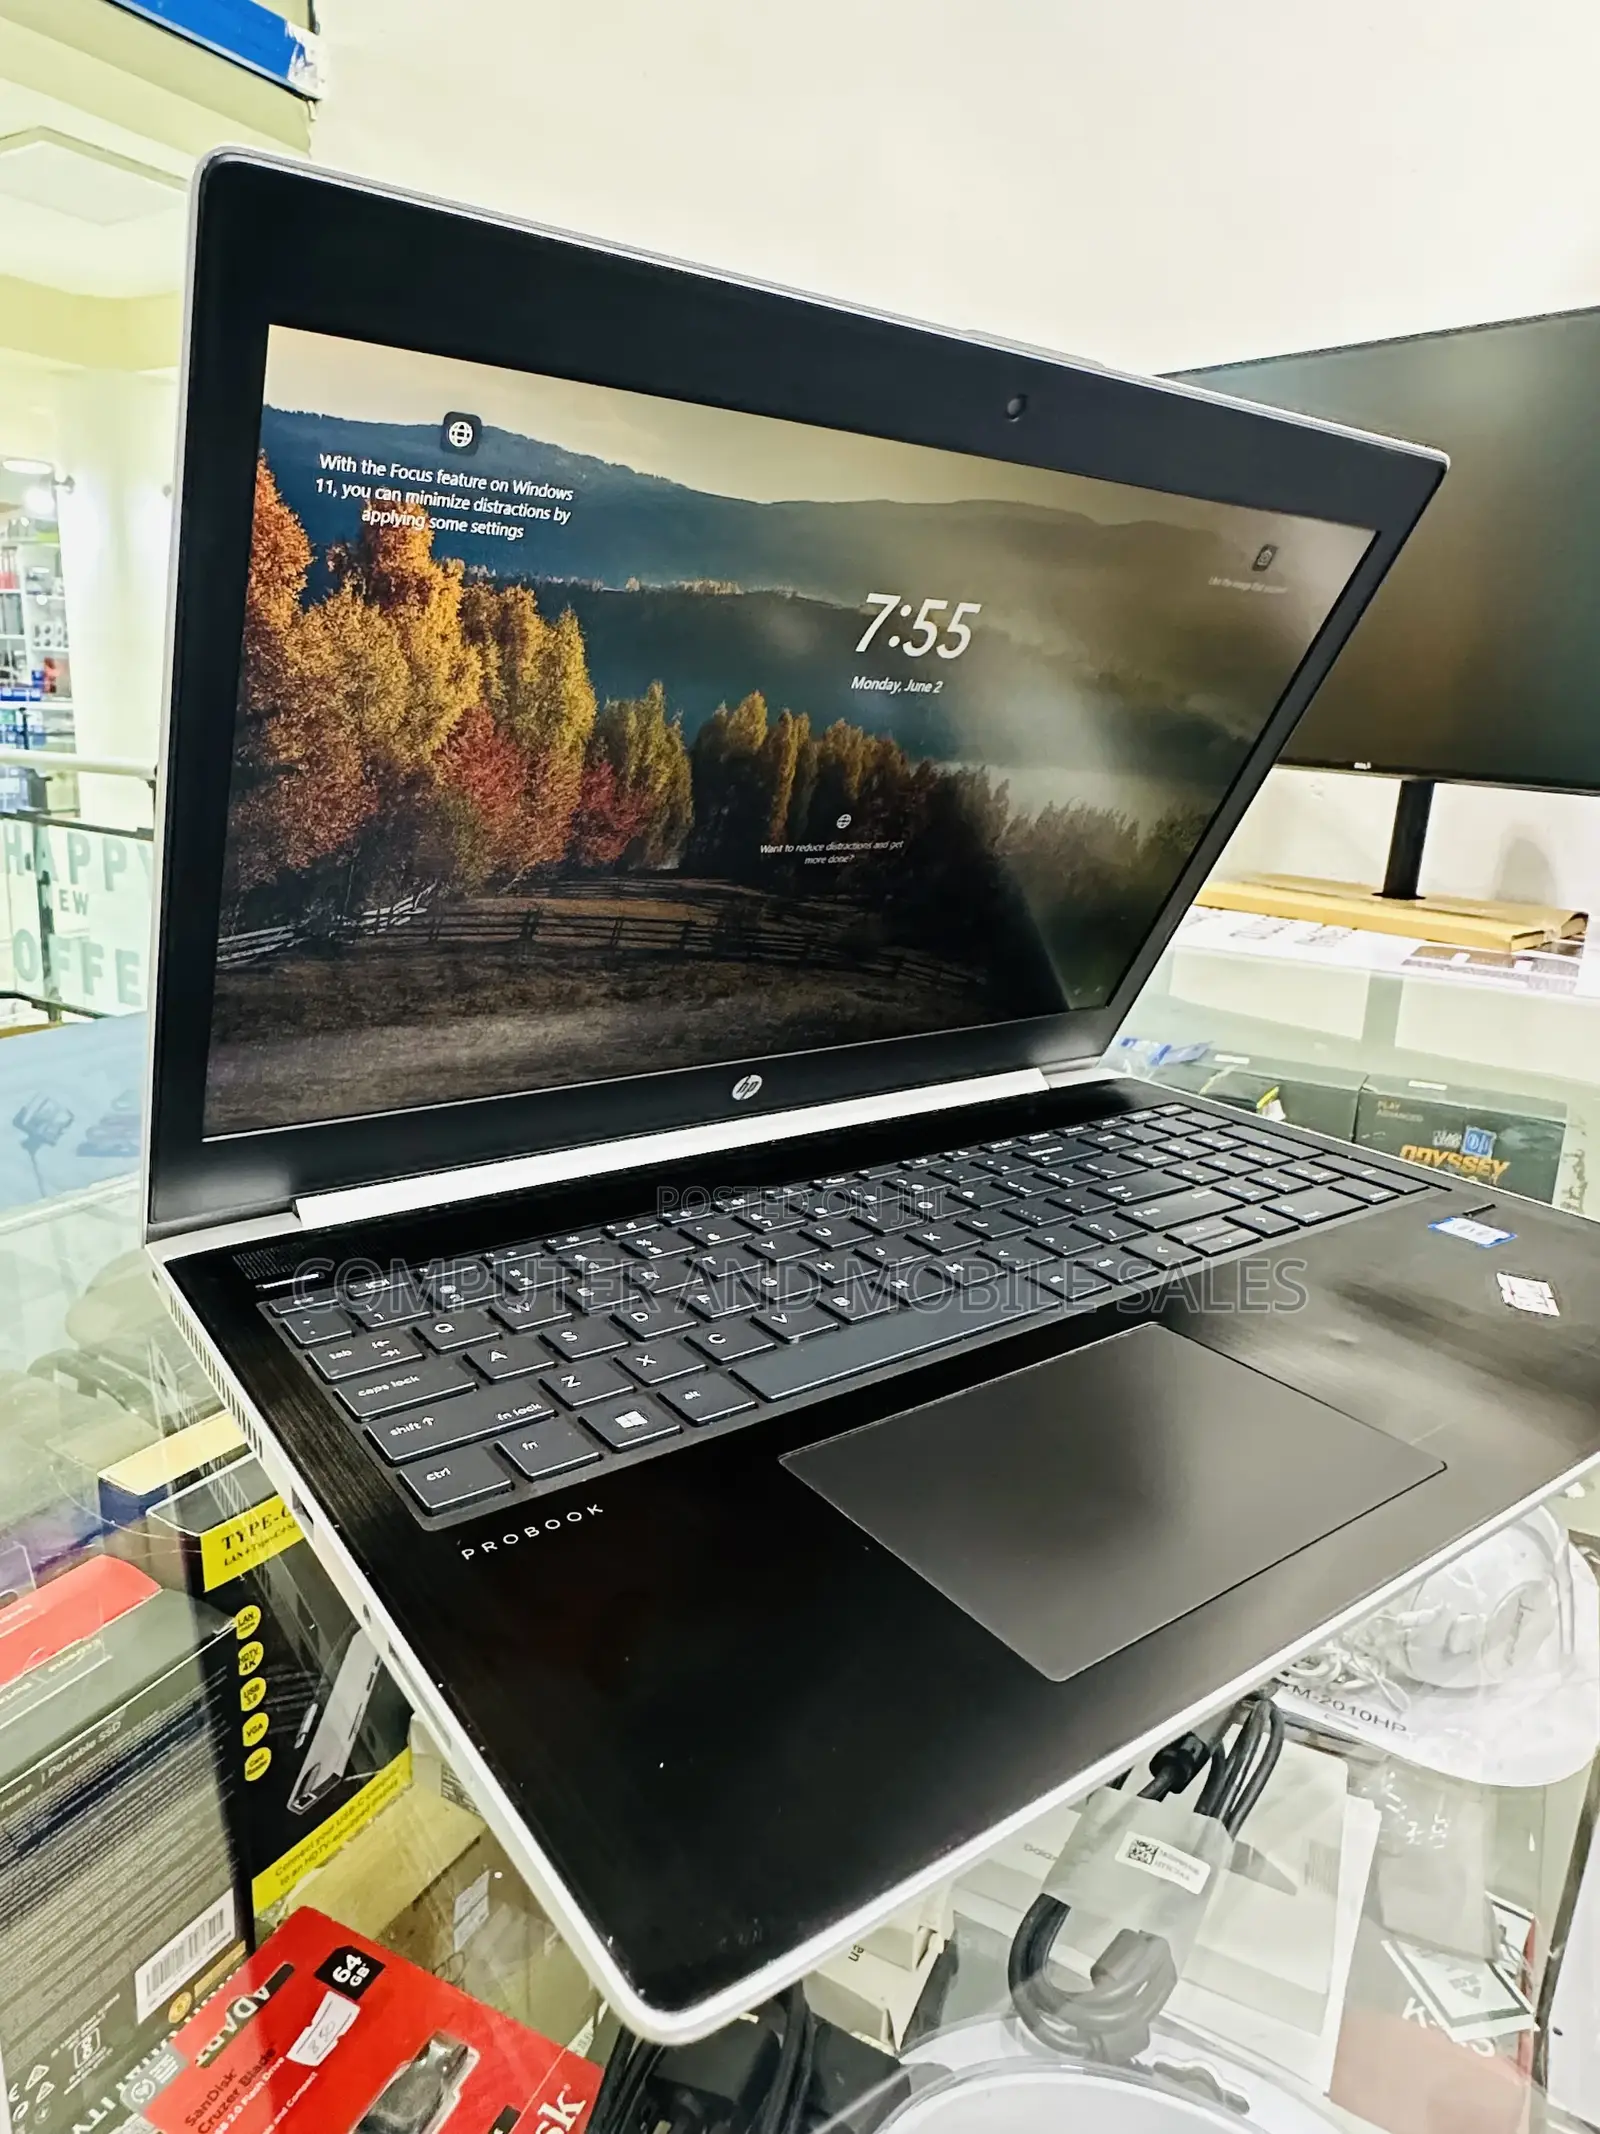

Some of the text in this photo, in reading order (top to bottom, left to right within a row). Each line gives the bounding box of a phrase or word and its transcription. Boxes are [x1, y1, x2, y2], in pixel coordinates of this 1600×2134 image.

[319, 454, 573, 501] With the Focus feature on Windows
[315, 478, 571, 525] 11, you can minimize distractions by
[361, 508, 524, 541] applying some settings
[855, 593, 982, 659] 7:55
[851, 676, 944, 694] Monday, June 2
[760, 840, 904, 854] Want to reduce distractions and get
[804, 854, 855, 865] more done?
[731, 1074, 763, 1101] hp
[761, 1240, 776, 1250] Y
[508, 1302, 531, 1314] W
[631, 1311, 649, 1323] D
[771, 1313, 788, 1324] V
[434, 1322, 455, 1334] Q
[561, 1331, 578, 1343] S
[708, 1333, 726, 1345] C
[328, 1349, 352, 1360] tab
[491, 1350, 508, 1362] A
[636, 1354, 656, 1367] X
[357, 1375, 420, 1397] caps lock
[561, 1375, 581, 1388] Z
[497, 1402, 542, 1421] fn lock
[390, 1421, 421, 1436] shift
[522, 1440, 538, 1451] fn
[426, 1467, 451, 1481] ctrl
[461, 1504, 603, 1560] PROBOOK
[238, 1612, 254, 1627] LAN
[243, 1660, 256, 1671] 4K
[247, 1723, 263, 1737] VGA
[48, 1739, 97, 1778] Portable
[98, 1721, 121, 1742] SSD
[332, 1954, 364, 1983] 64
[198, 2048, 276, 2134] Cruzer Blade
[227, 2105, 243, 2123] 2.0
[262, 2057, 284, 2082] Drive
[185, 2068, 237, 2127] SanDisk
